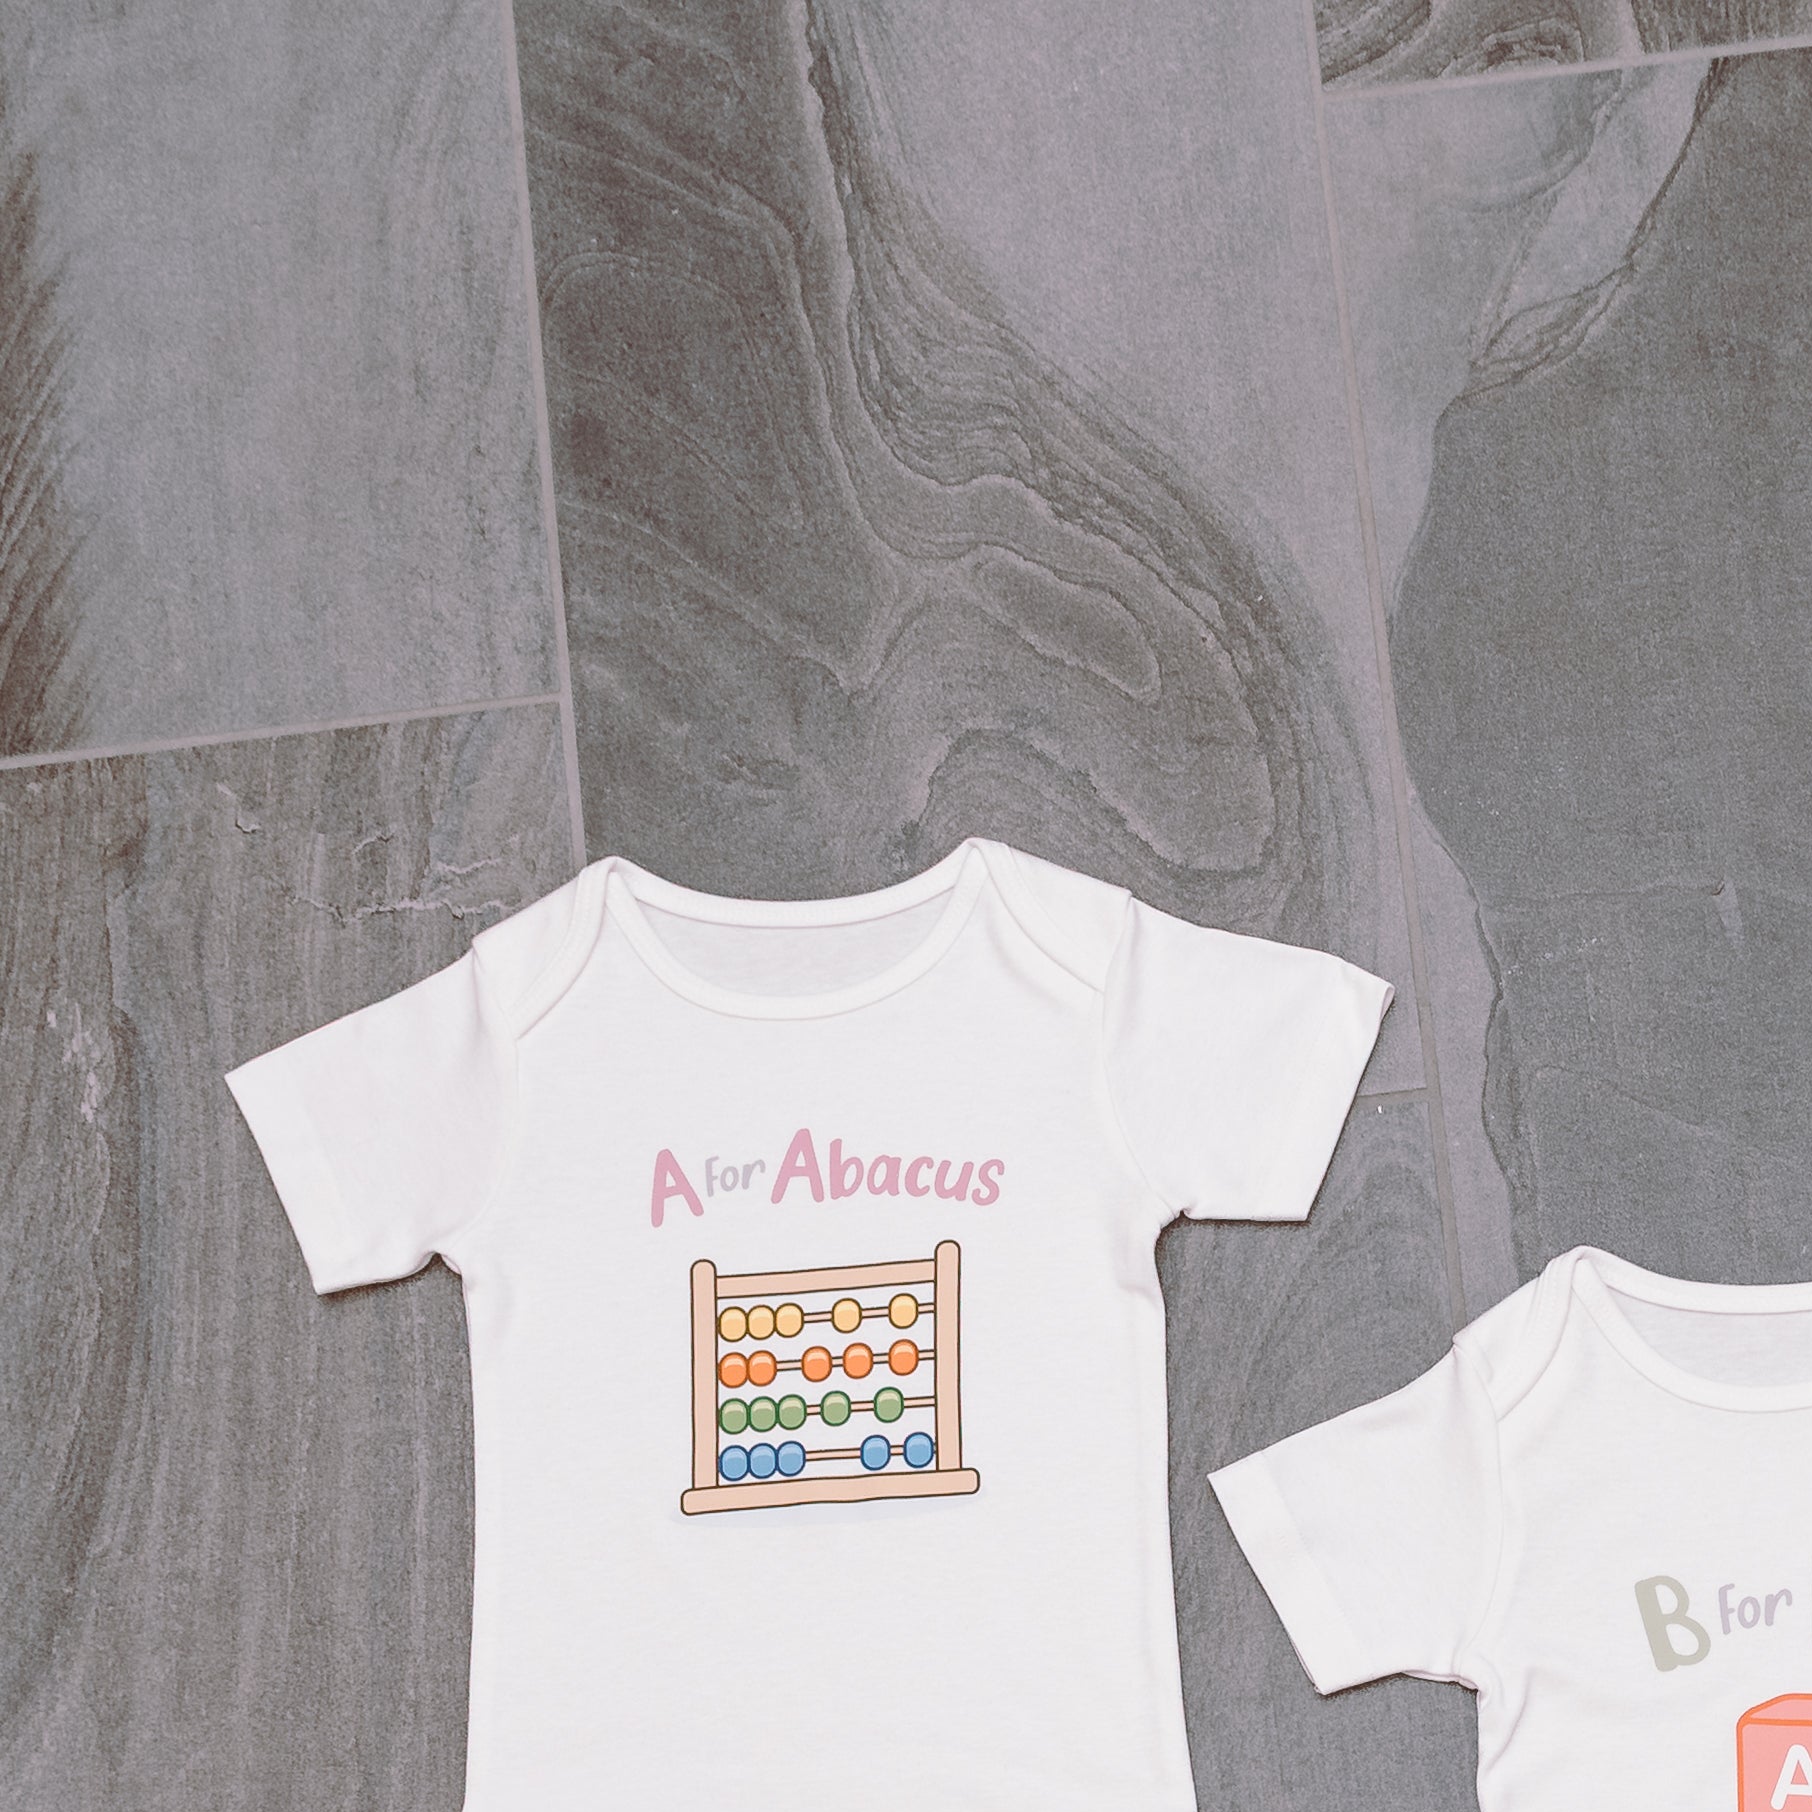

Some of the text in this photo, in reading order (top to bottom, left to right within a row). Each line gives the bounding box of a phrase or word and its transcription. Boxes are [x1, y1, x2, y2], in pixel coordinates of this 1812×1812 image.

[651, 1149, 704, 1228] A
[770, 1128, 1005, 1206] Abacus
[1634, 1575, 1711, 1672] B
